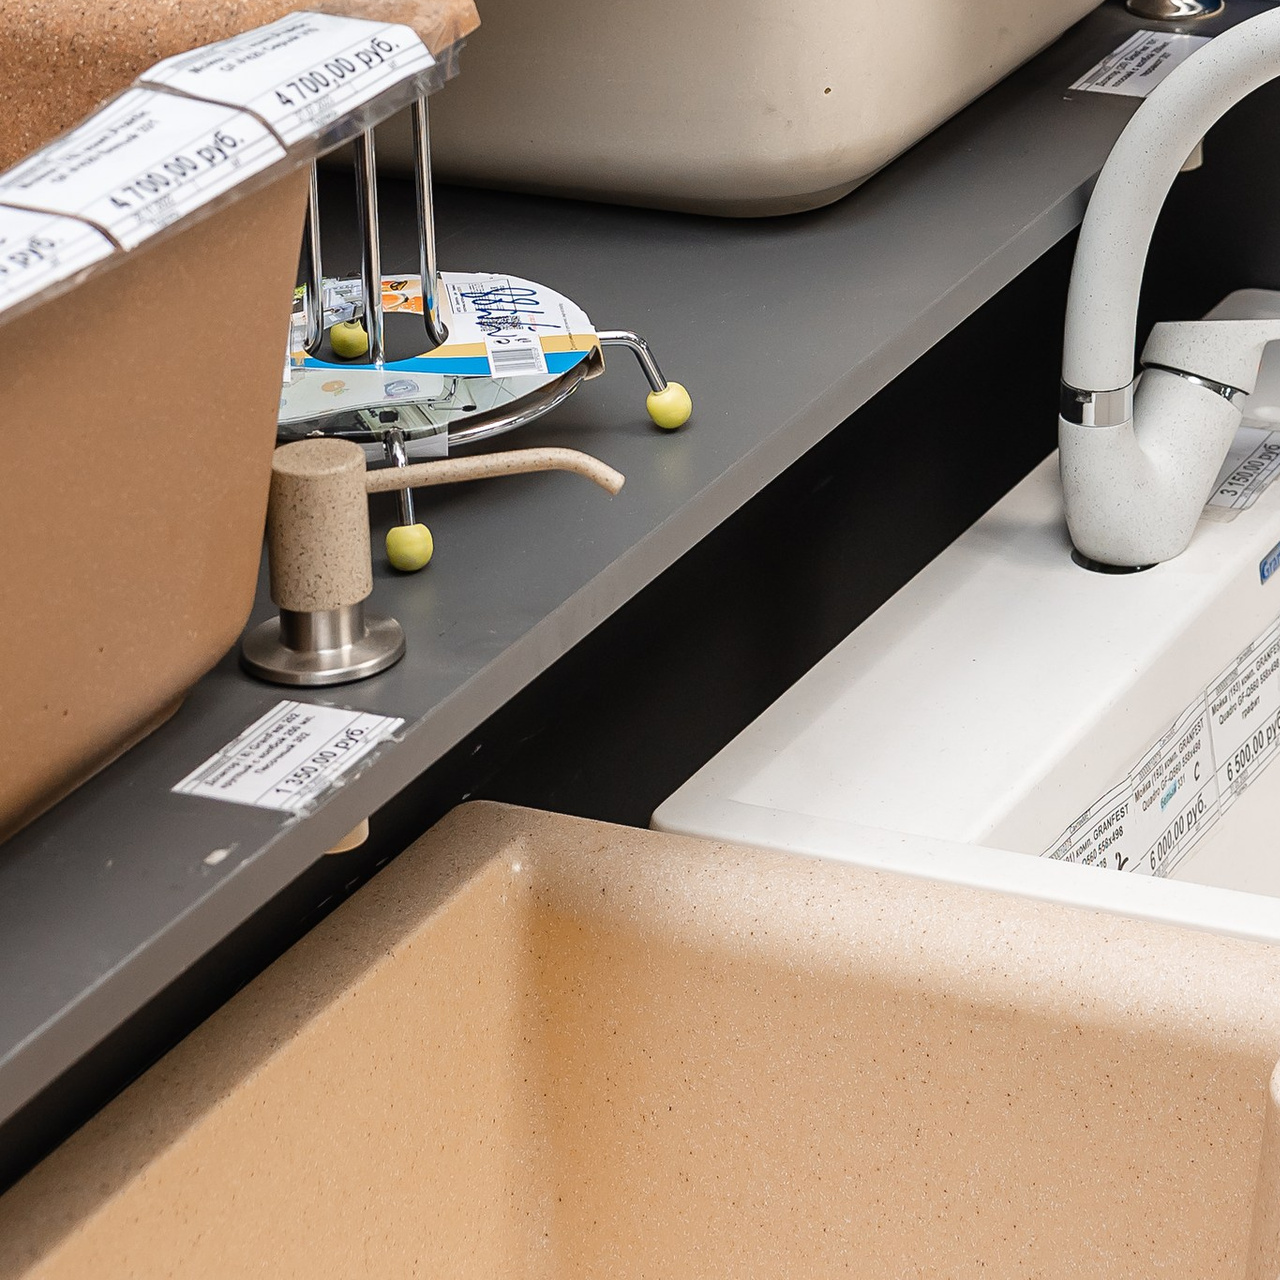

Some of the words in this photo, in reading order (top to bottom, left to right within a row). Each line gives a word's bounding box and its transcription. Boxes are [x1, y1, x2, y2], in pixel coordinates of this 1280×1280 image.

[274, 90, 294, 108] 4
[293, 58, 356, 100] 700,00
[355, 38, 400, 70] руб.
[110, 196, 130, 209] 4
[122, 156, 198, 200] 700,00
[197, 130, 245, 168] руб.
[1220, 489, 1238, 497] 3
[1227, 460, 1265, 487] 150,00
[1211, 695, 1228, 716] Мойка
[1228, 683, 1241, 702] (193)
[1241, 669, 1256, 688] комп.
[1218, 702, 1238, 725] Quadro
[1241, 695, 1260, 720] графит
[286, 751, 337, 785] 350,00
[336, 726, 370, 751] руб.
[1134, 781, 1151, 803] Мойка
[1150, 766, 1164, 787] (192)
[1164, 752, 1178, 769] комп.
[1178, 718, 1203, 755] GRANFEST
[1227, 762, 1233, 781] 6
[1234, 730, 1264, 774] 500,00
[1142, 789, 1160, 812] Quadro
[1160, 781, 1177, 810] белый
[1076, 839, 1093, 856] комп.
[1093, 803, 1130, 840] GRANFEST
[1097, 826, 1124, 855] 558x498
[1150, 850, 1156, 870] 6
[1157, 820, 1184, 862] 000,00
[1187, 792, 1207, 831] руб.
